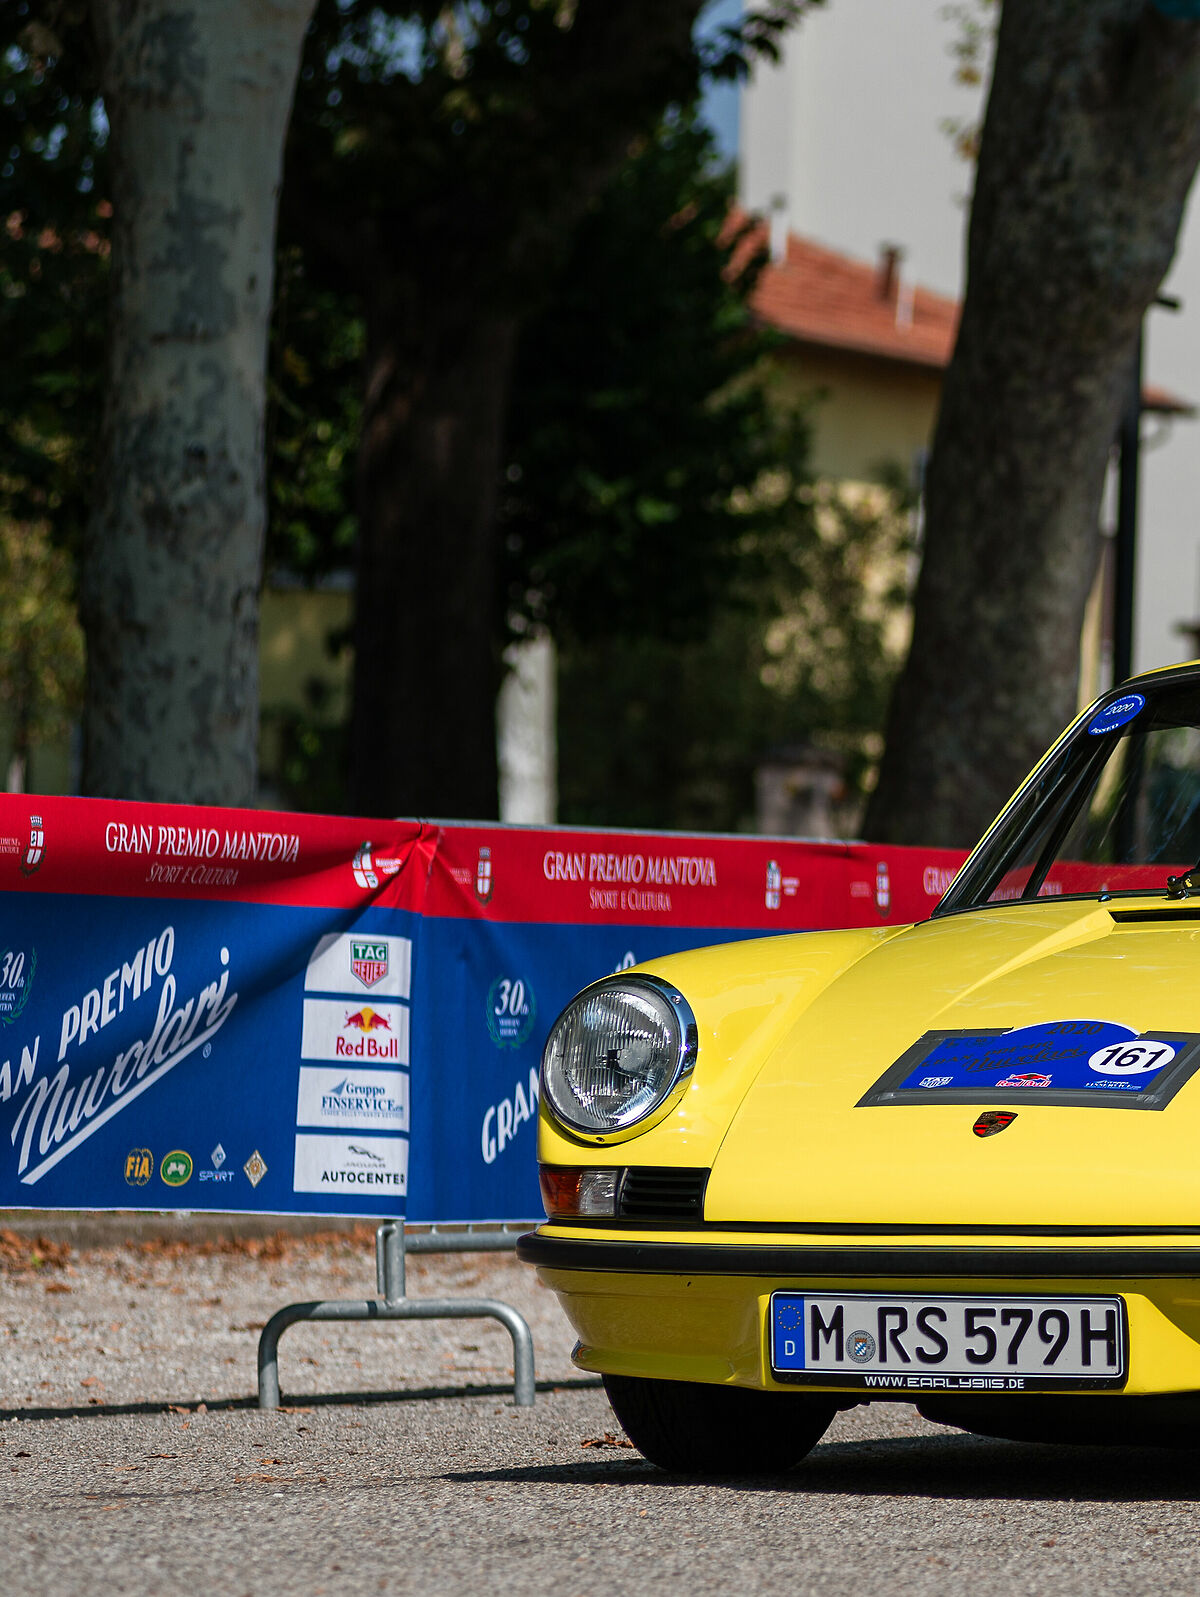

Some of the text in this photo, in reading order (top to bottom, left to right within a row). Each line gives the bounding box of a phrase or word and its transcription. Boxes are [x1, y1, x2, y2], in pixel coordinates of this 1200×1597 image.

[105, 821, 301, 864] GRAN PREMIO MANTOVA
[543, 850, 717, 887] GRAN PREMIO MANTOVA
[355, 945, 385, 960] TAG
[353, 961, 387, 985] HEUER
[57, 925, 175, 1063] PREMIO
[1045, 1022, 1105, 1036] 2020
[336, 1036, 398, 1058] Red Bull
[1099, 1046, 1168, 1069] 161
[11, 947, 238, 1177] Nuvolari
[346, 1083, 386, 1098] Gruppo
[1022, 1080, 1053, 1088] Bull
[481, 1066, 540, 1165] GRAN
[199, 1170, 235, 1182] SPORT
[810, 1304, 844, 1362] M
[877, 1306, 949, 1364] RS
[784, 1340, 796, 1356] D
